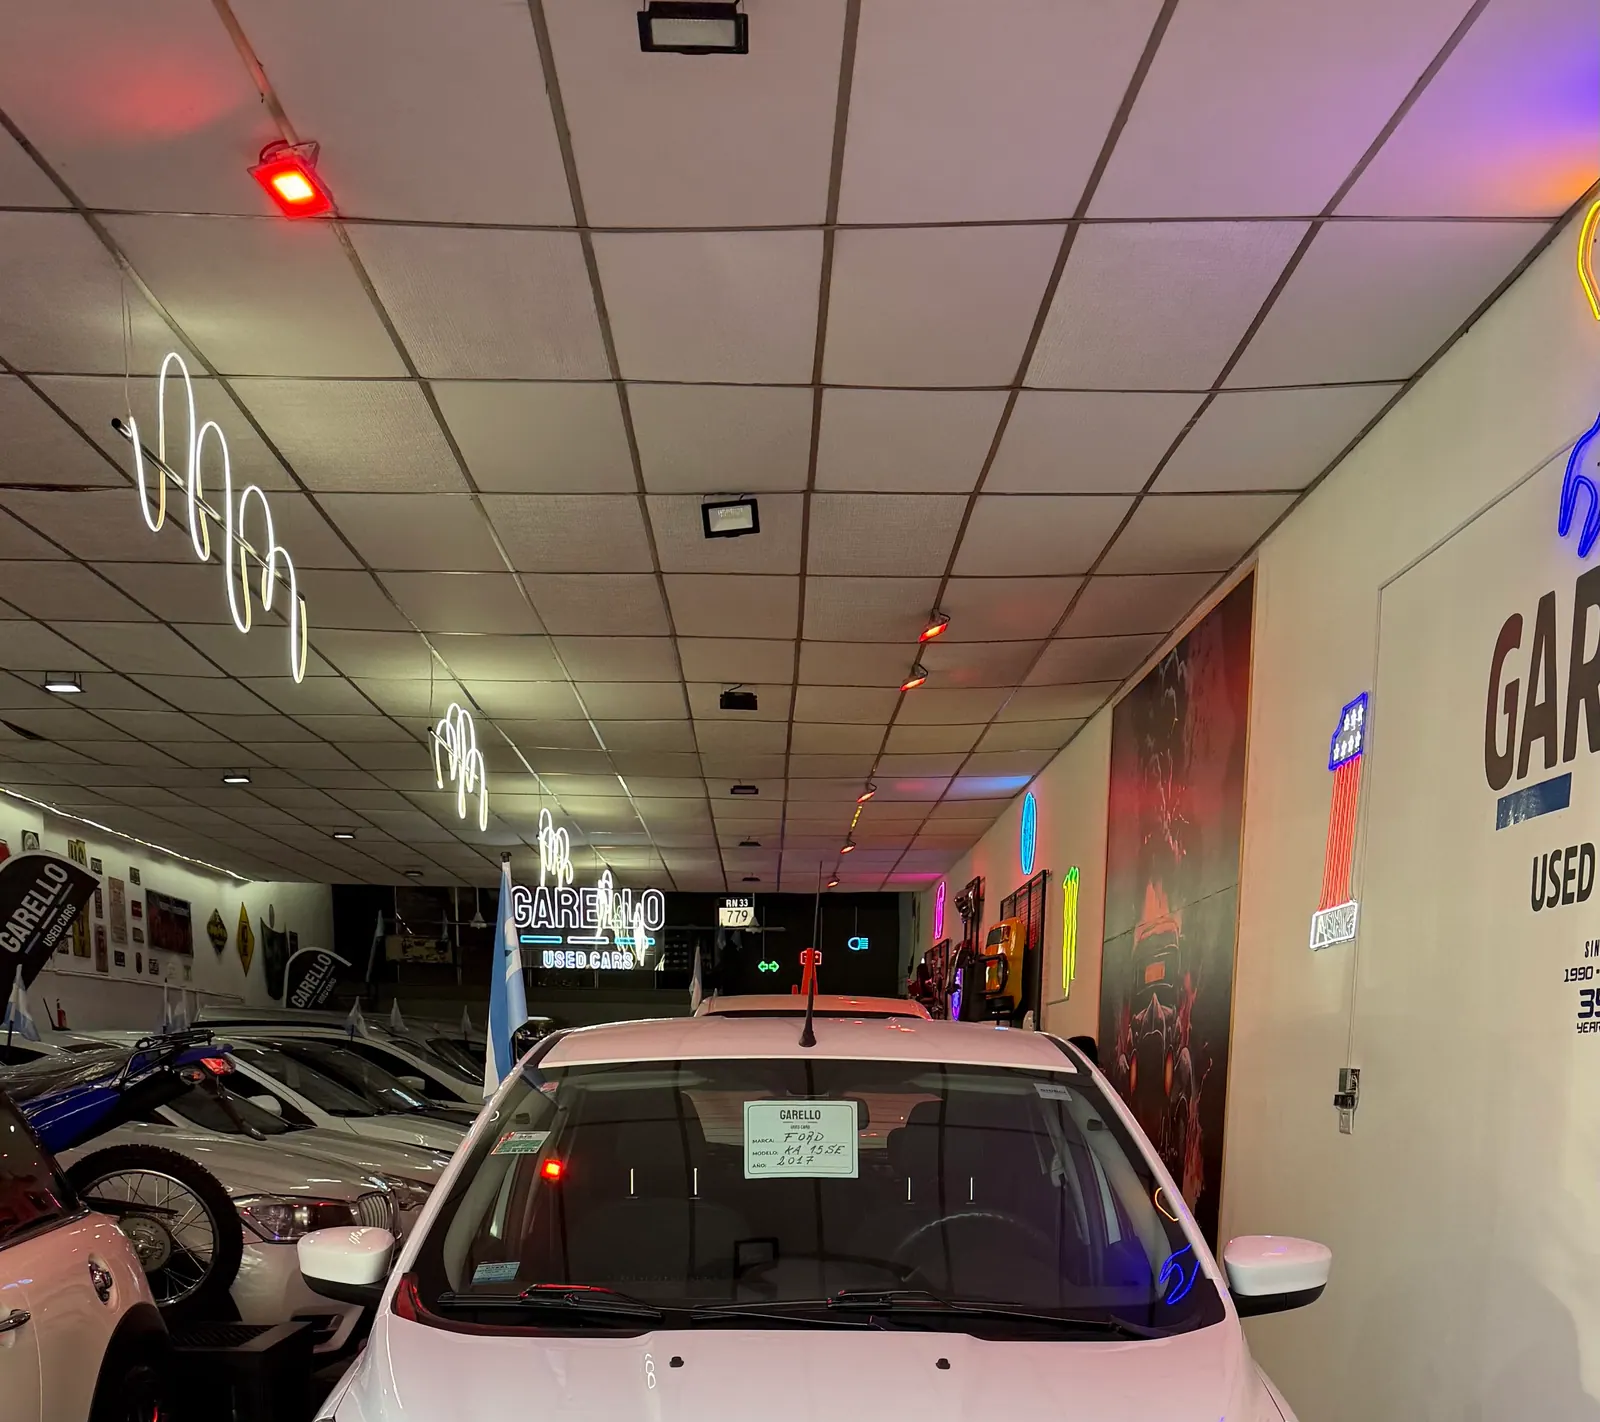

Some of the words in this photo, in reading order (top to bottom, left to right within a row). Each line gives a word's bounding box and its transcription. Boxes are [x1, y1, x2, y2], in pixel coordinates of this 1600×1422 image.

[1531, 842, 1596, 912] USED
[0, 863, 68, 953] GARELLO
[726, 899, 738, 907] RN
[739, 899, 748, 907] 33
[727, 910, 748, 923] 779
[43, 924, 62, 947] USED
[58, 903, 77, 926] CARS
[543, 950, 587, 969] USED
[590, 951, 634, 970] CARS
[291, 953, 332, 1008] GARELLO
[1564, 966, 1594, 982] 1990
[780, 1110, 821, 1120] GARELLO
[783, 1131, 824, 1145] FORD
[784, 1145, 802, 1155] KA
[777, 1155, 814, 1166] 2017
